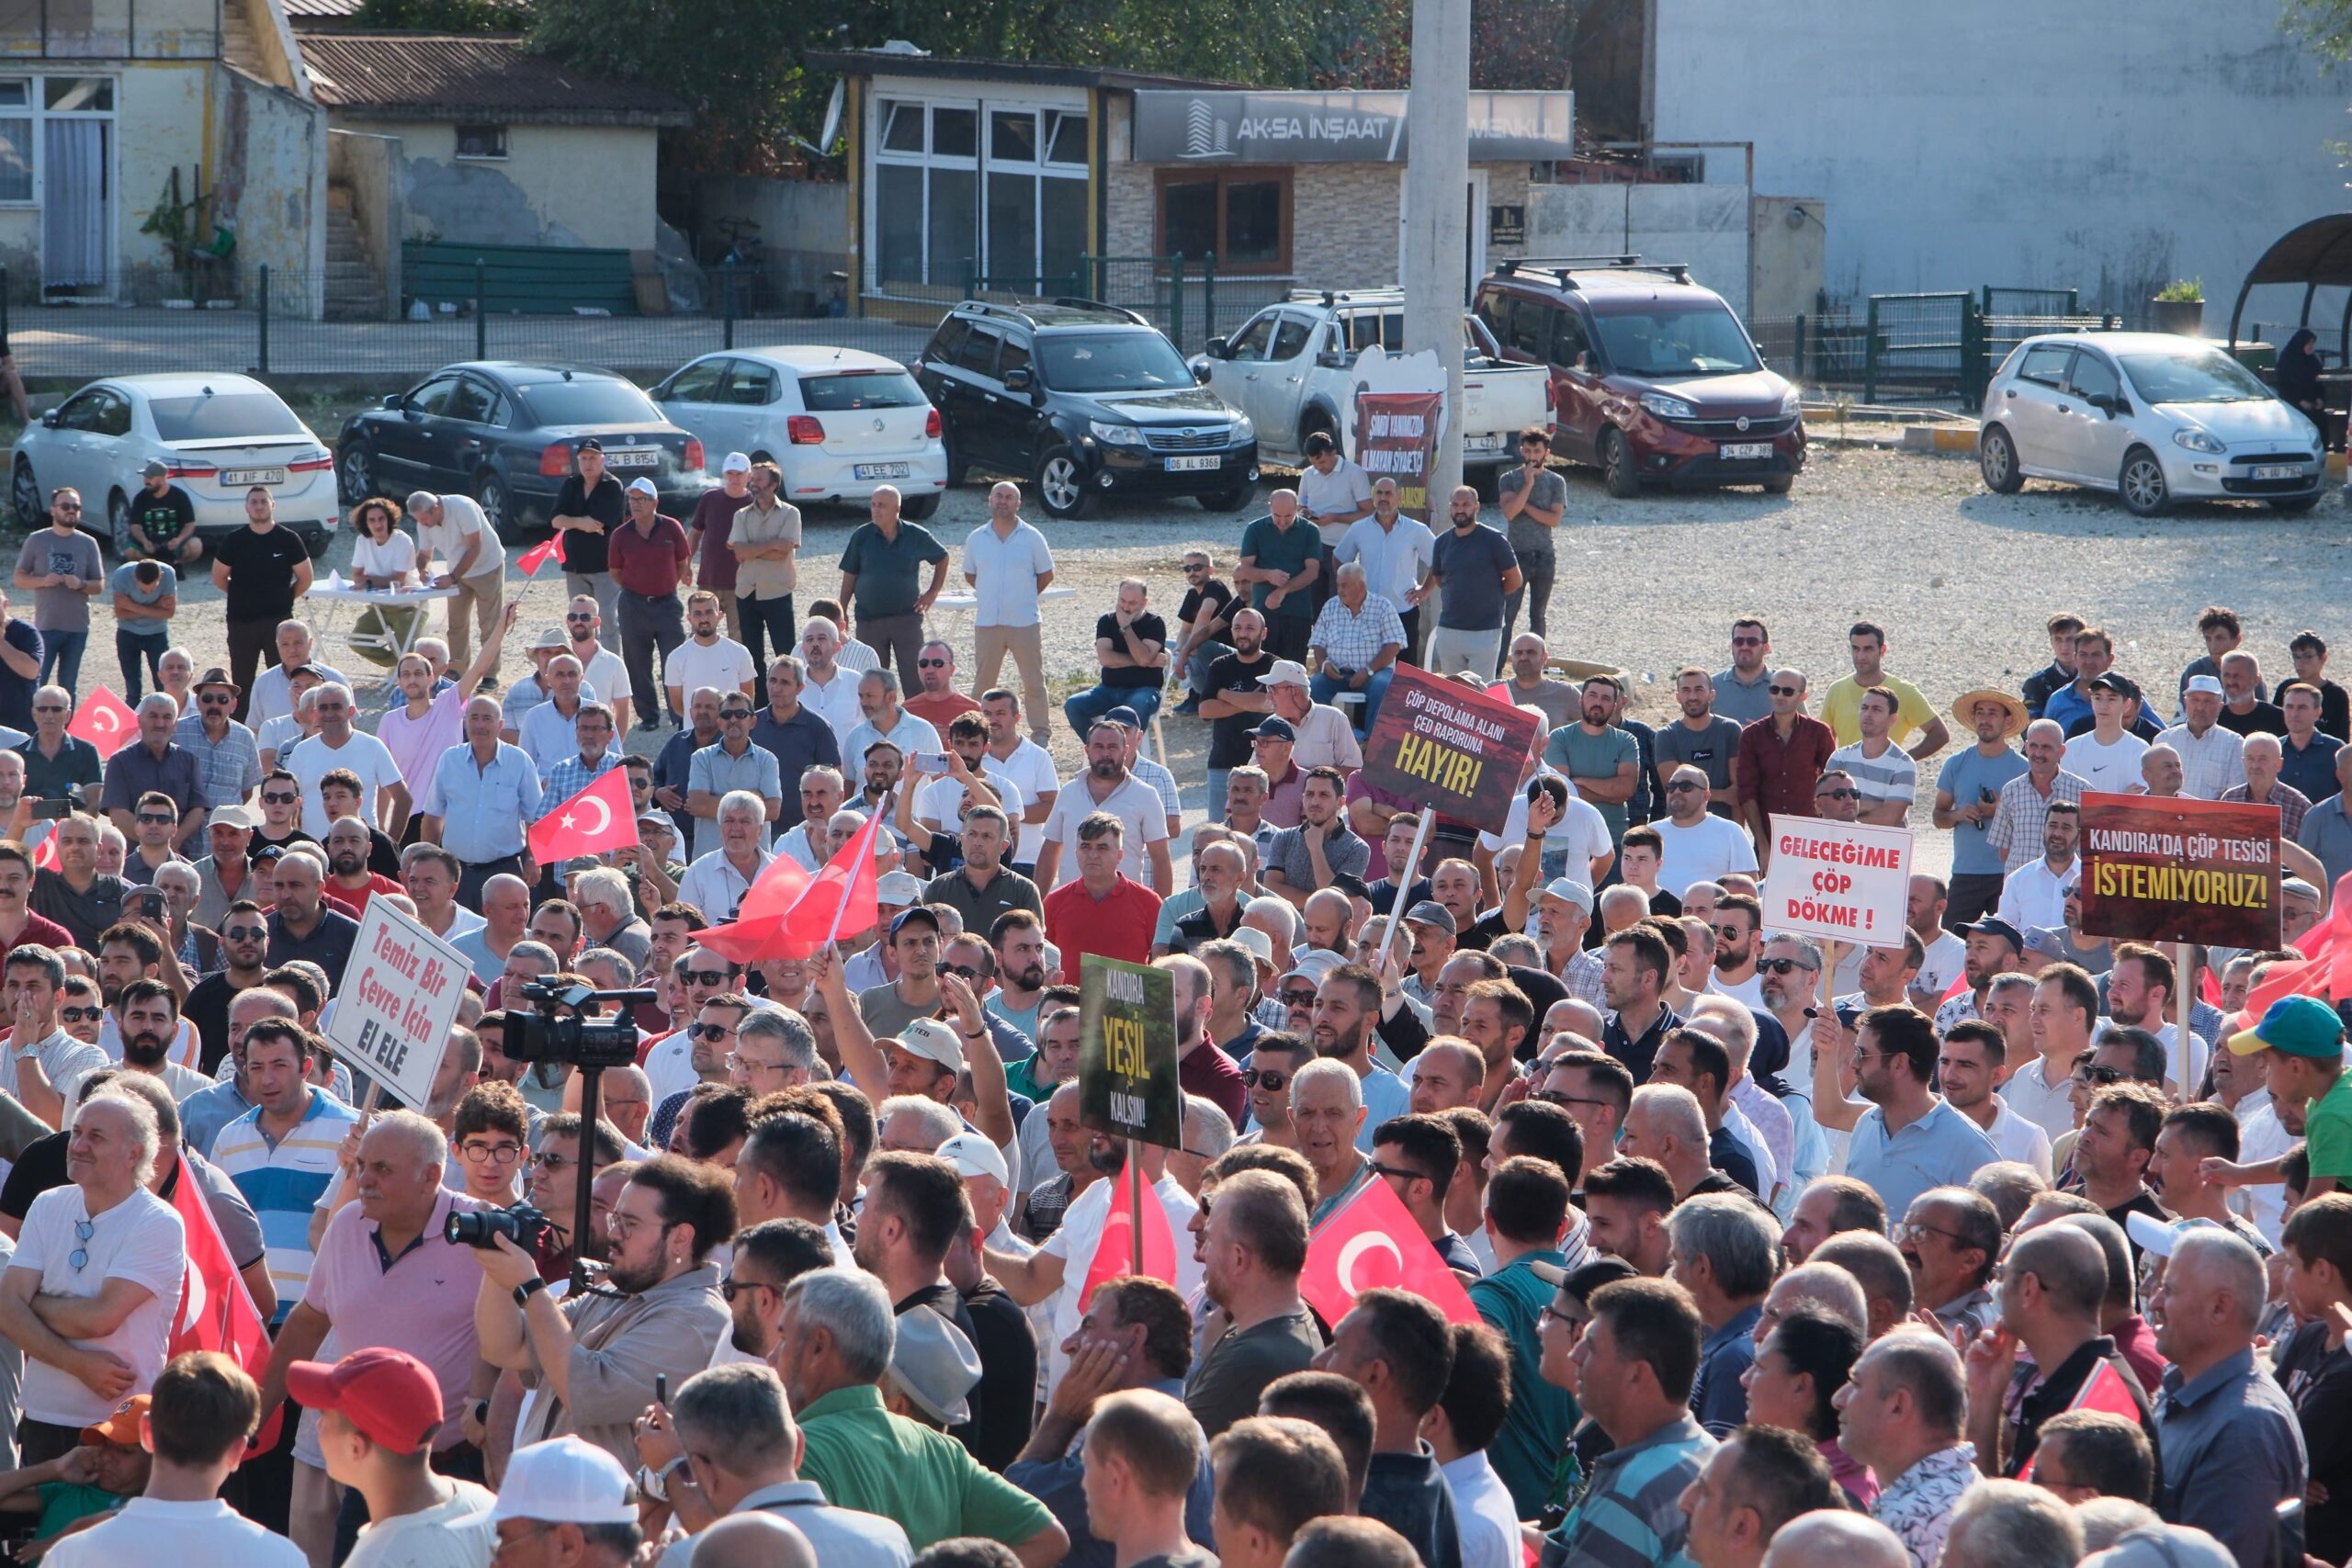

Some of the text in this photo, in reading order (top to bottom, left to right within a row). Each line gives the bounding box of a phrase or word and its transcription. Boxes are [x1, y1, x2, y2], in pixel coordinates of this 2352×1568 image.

[1309, 113, 1388, 143] İNŞAAT
[1467, 117, 1563, 140] MENKUL
[608, 454, 656, 465] 54 B 8154
[1480, 437, 1495, 448] 422
[228, 472, 238, 483] 41
[265, 470, 281, 481] 470
[861, 464, 906, 475] 41 EE 702
[1170, 459, 1182, 469] 06
[1186, 458, 1195, 468] AL
[1405, 690, 1505, 742] ÇÖP DEPOLAMA ALANI
[1413, 715, 1484, 754] ÇED RAPORUNA
[1395, 732, 1484, 798] HAYIR!
[2090, 829, 2271, 863] KANDIRA'DA ÇÖP TESİSİ
[1812, 867, 1852, 897] ÇÖP
[2094, 855, 2267, 909] İSTEMİYORUZ!
[1787, 896, 1858, 928] DÖKME
[371, 921, 448, 998] Temiz Bir
[1106, 967, 1145, 1005] KANDIRA
[356, 966, 433, 1044] Çevre İçin
[913, 1027, 931, 1038] TEB
[1103, 1010, 1151, 1088] YEŞİL
[375, 1031, 409, 1077] ELE
[1110, 1091, 1147, 1128] KALSIN!
